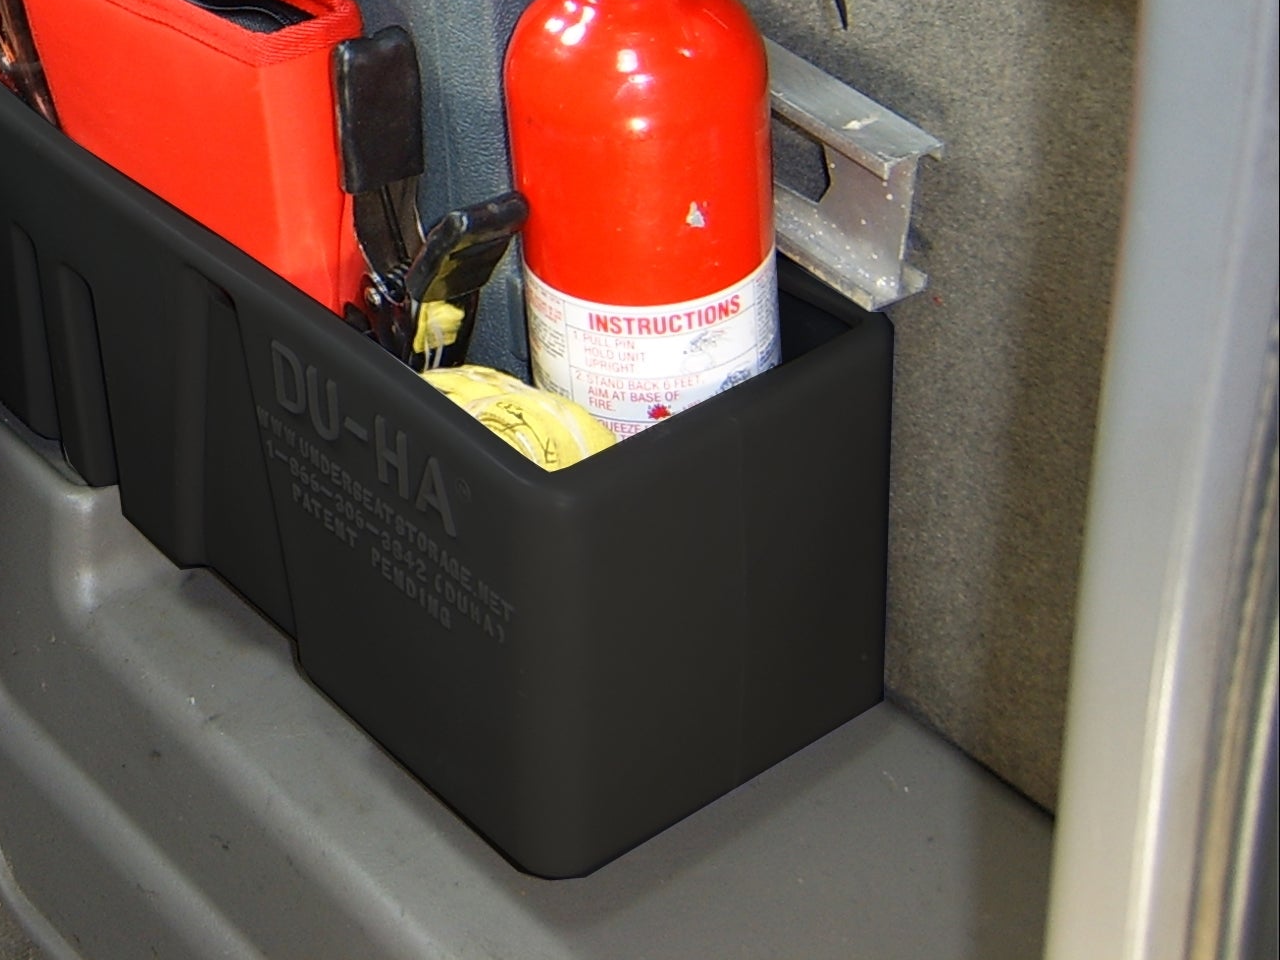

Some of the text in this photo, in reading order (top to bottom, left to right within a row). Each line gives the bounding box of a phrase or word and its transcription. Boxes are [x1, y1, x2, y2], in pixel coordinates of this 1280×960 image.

[588, 294, 741, 335] INSTRUCTIONS
[583, 333, 609, 348] PULL
[615, 339, 635, 350] PIN
[585, 347, 645, 362] HOLD UNIT
[586, 357, 635, 373] UPRIGHT
[586, 374, 624, 390] STAND
[628, 380, 659, 391] BACK
[587, 386, 681, 403] AIM AT BASE OF
[271, 339, 456, 537] DU-HA
[292, 483, 451, 630] PATENT PENDING
